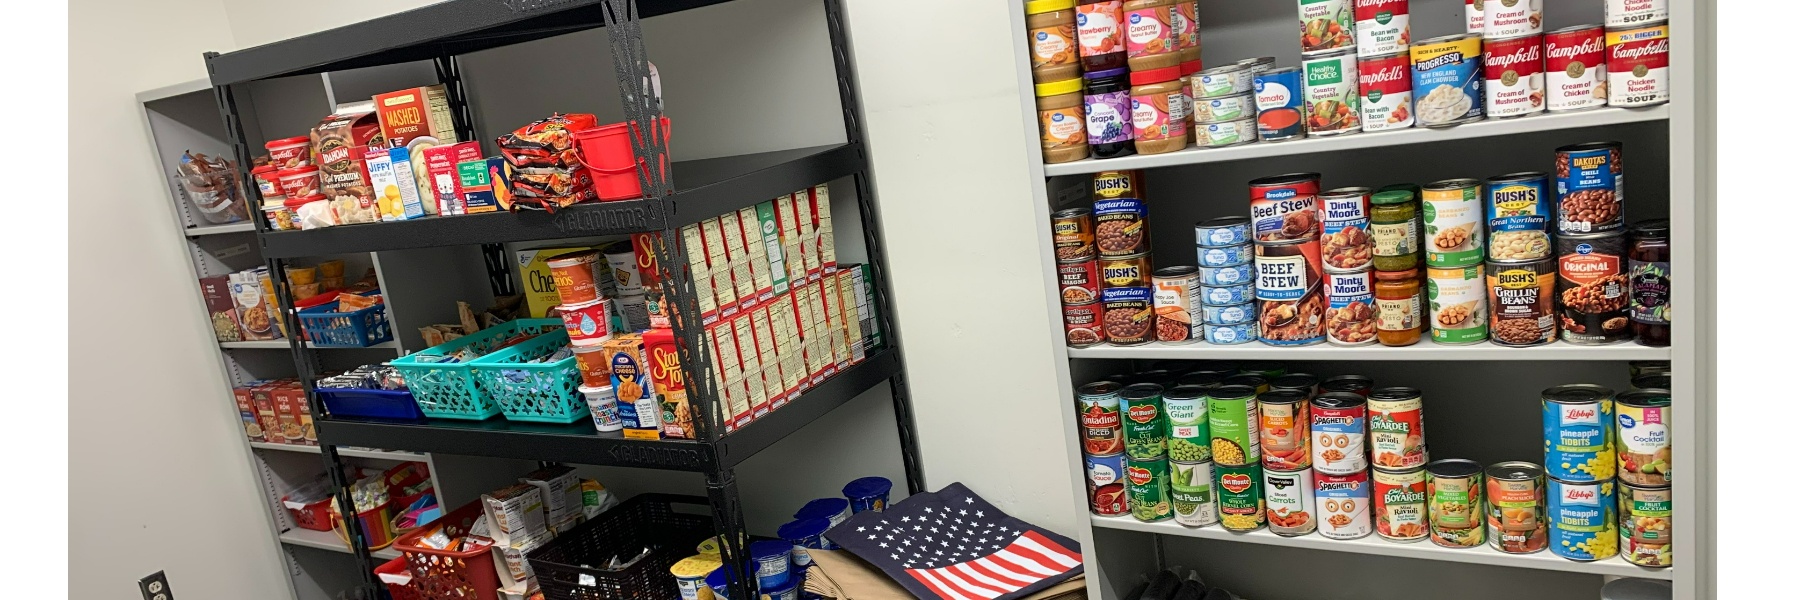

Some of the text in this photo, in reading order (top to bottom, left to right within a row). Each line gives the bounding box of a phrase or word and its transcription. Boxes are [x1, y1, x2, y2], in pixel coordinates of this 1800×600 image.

[1625, 4, 1652, 12] Noodle
[1304, 11, 1331, 19] Vegetable
[1623, 13, 1654, 23] SOUP
[1494, 18, 1527, 26] Mushroom
[1131, 24, 1157, 34] Creamy
[1634, 30, 1662, 39] BIGGER
[1546, 36, 1605, 59] Campbell's
[1613, 39, 1670, 60] Campbell's
[1418, 53, 1460, 71] PROGRESSO
[1485, 45, 1539, 68] Campbell's
[1310, 71, 1337, 81] Choice
[1312, 66, 1336, 75] Healthy
[1433, 76, 1459, 84] CHOWDER
[1564, 89, 1590, 97] Chicken
[1628, 85, 1655, 93] Noodle
[1259, 95, 1285, 103] Tomato
[1312, 92, 1339, 100] Vegetable
[1495, 97, 1528, 105] Mushroom
[1626, 94, 1657, 103] SOUP
[385, 106, 421, 128] MASHED
[1091, 115, 1116, 125] Grape
[394, 125, 418, 135] POTATOES
[322, 147, 349, 164] IDAHOAN
[369, 161, 390, 172] JIFFY
[1573, 156, 1606, 167] DAKOTA'S
[333, 172, 360, 180] PREMIUM
[1096, 177, 1129, 191] BUSH'S
[1496, 190, 1536, 204] BUSH'S
[1095, 200, 1136, 211] Vegetarian
[1253, 194, 1314, 218] Beef Stew
[1330, 200, 1357, 211] Dinty
[565, 207, 647, 231] GLADIATOR
[1098, 214, 1113, 222] BAKED
[1328, 208, 1360, 219] Moore
[1344, 217, 1367, 226] STEW
[1491, 216, 1544, 227] Great Northern
[1056, 224, 1077, 232] BUSH'S
[1261, 263, 1295, 275] BEEF
[1564, 261, 1610, 272] ORIGINAL
[1105, 266, 1138, 279] BUSH'S
[1262, 275, 1300, 288] STEW
[1336, 276, 1363, 286] Dinty
[1499, 273, 1535, 284] BUSH'S
[1104, 288, 1144, 298] Vegetarian
[1334, 286, 1366, 294] Moore
[1494, 287, 1539, 298] GRILLIN'
[1501, 295, 1537, 306] BEANS
[1565, 408, 1595, 420] Libby's
[1083, 414, 1117, 427] Contadina
[1370, 420, 1409, 432] BOYARDEE
[1376, 436, 1400, 444] Ravioli
[1560, 429, 1599, 440] pineapple
[1562, 438, 1590, 446] TIDBITS
[1269, 496, 1296, 504] Carrots
[1384, 492, 1425, 504] BOYARDEE
[1564, 489, 1595, 500] Libby's
[1394, 508, 1419, 516] Ravioli
[1560, 508, 1598, 519] pineapple
[1562, 518, 1590, 526] TIDBITS
